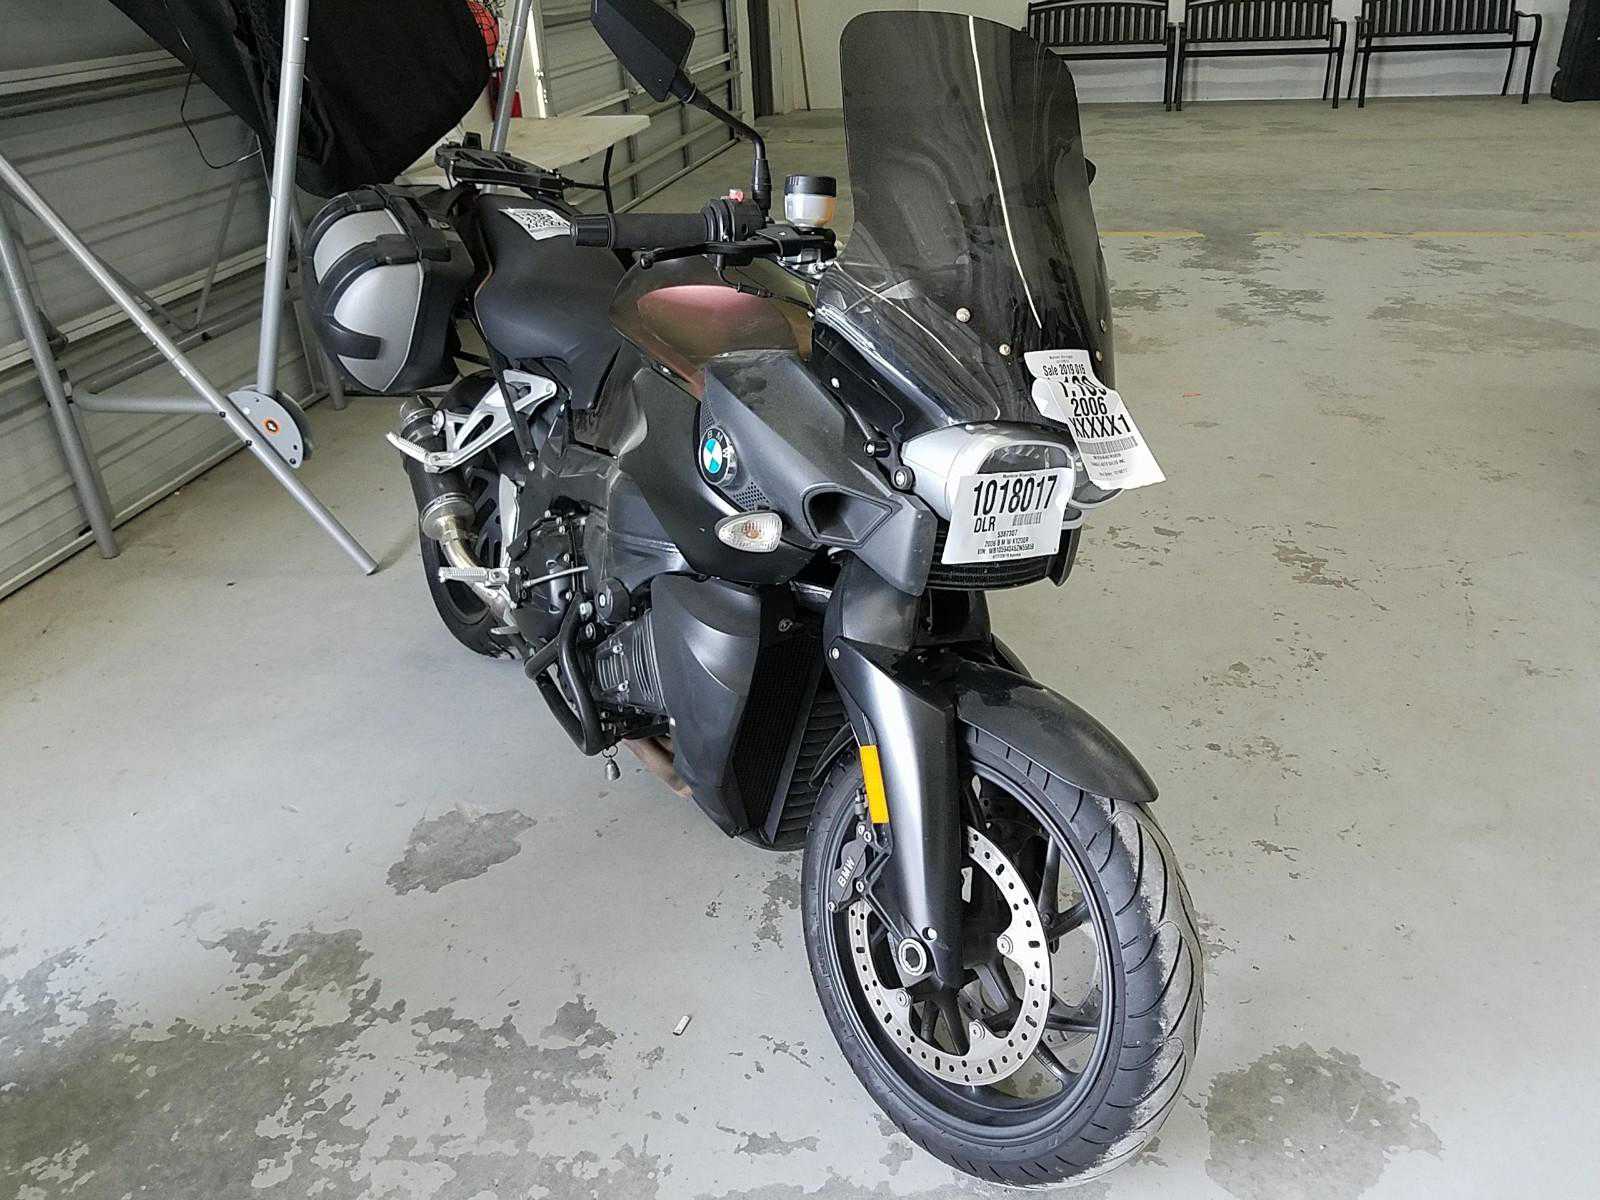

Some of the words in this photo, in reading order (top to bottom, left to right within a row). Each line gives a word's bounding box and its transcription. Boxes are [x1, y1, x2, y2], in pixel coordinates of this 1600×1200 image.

[1043, 365, 1058, 376] Sale
[1059, 363, 1074, 375] 2019
[1071, 396, 1107, 417] 2006
[707, 430, 730, 458] BMW
[974, 475, 1058, 516] 1018017
[974, 515, 996, 533] DLR
[837, 855, 855, 888] BMW
